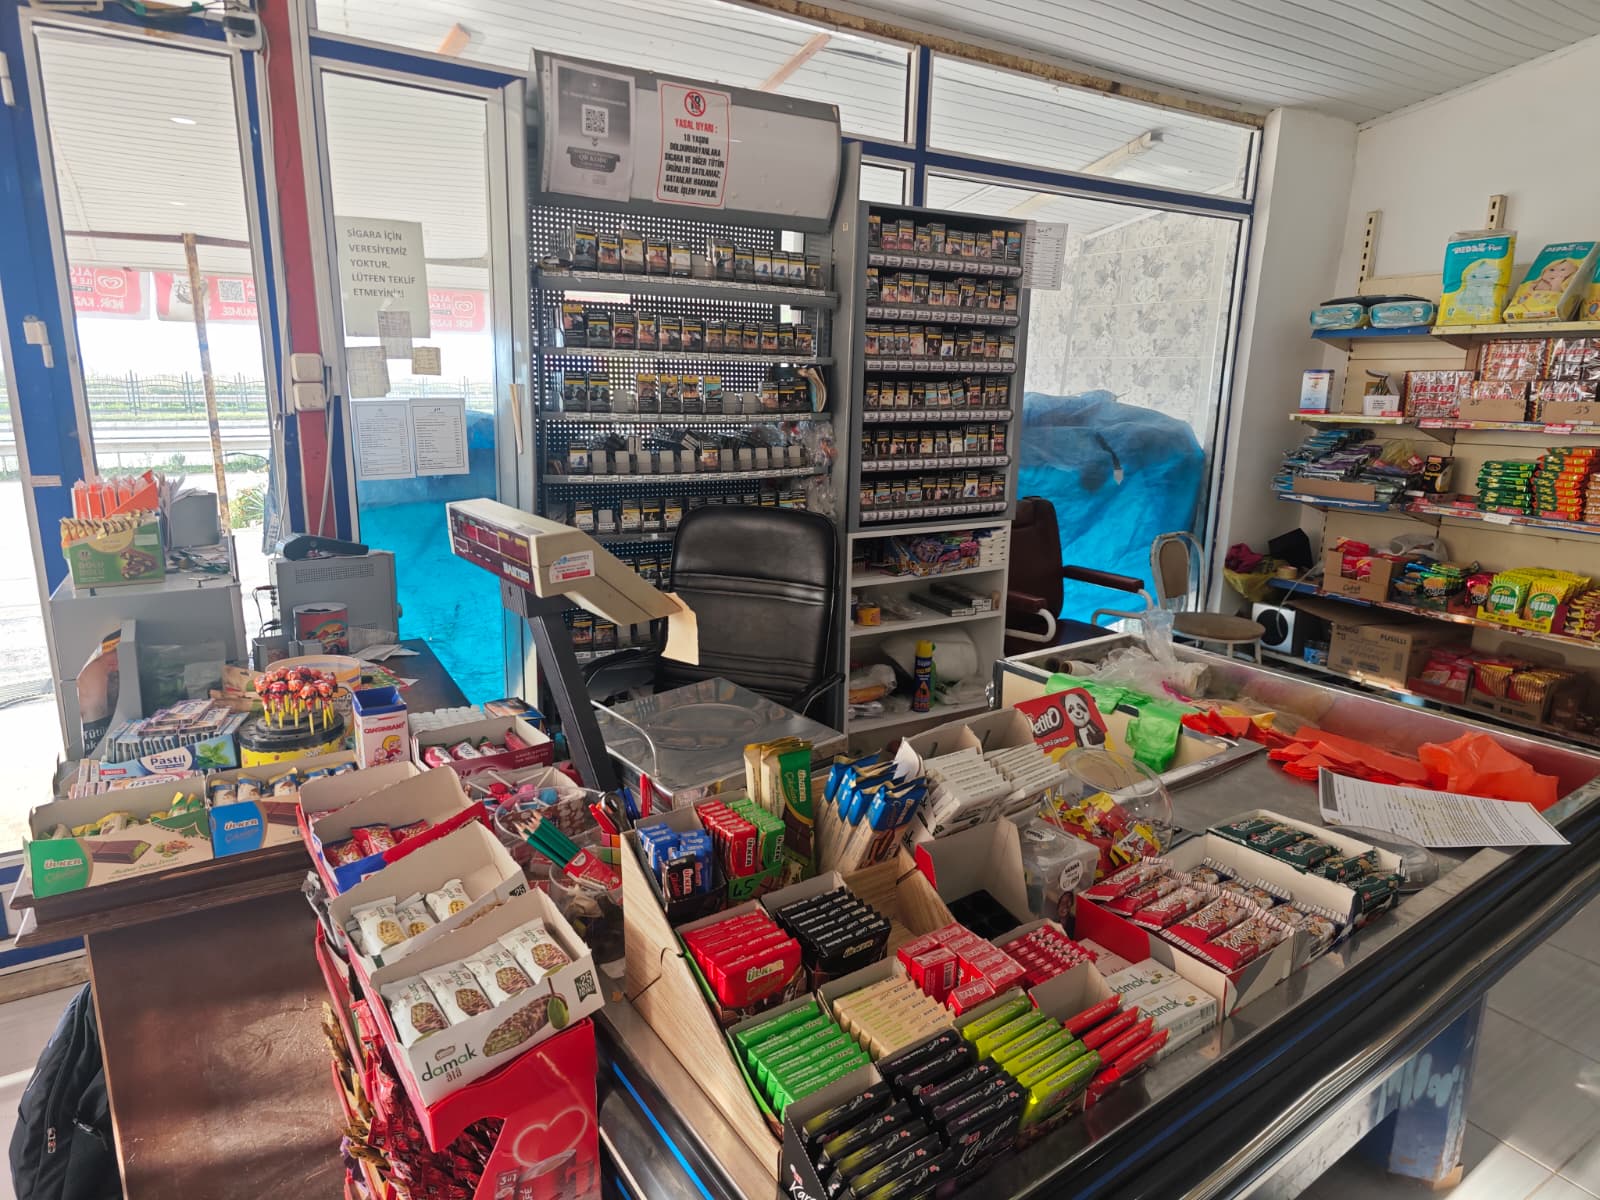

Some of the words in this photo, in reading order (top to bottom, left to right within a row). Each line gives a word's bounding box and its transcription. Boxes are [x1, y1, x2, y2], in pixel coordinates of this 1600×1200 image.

[675, 118, 694, 130] YASAL
[685, 156, 691, 164] VE
[708, 158, 725, 169] TÜTÜN
[665, 174, 692, 184] SATANLAR
[693, 178, 719, 188] HAKKINDA
[663, 184, 679, 194] YASAL
[347, 227, 382, 239] SİGARA
[384, 230, 402, 241] İÇİN
[348, 243, 408, 256] VERESİYEMİZ
[350, 258, 391, 269] YOKTUR.
[352, 271, 386, 283] LÜTFEN
[388, 274, 416, 285] TEKLİF
[1414, 381, 1456, 394] ÜLKER
[150, 755, 186, 766] Pastil
[745, 837, 755, 867] ÜLKER
[774, 835, 784, 862] ÜLKER
[683, 868, 694, 895] ÜLKER
[579, 971, 592, 984] 25
[421, 1043, 478, 1083] damak
